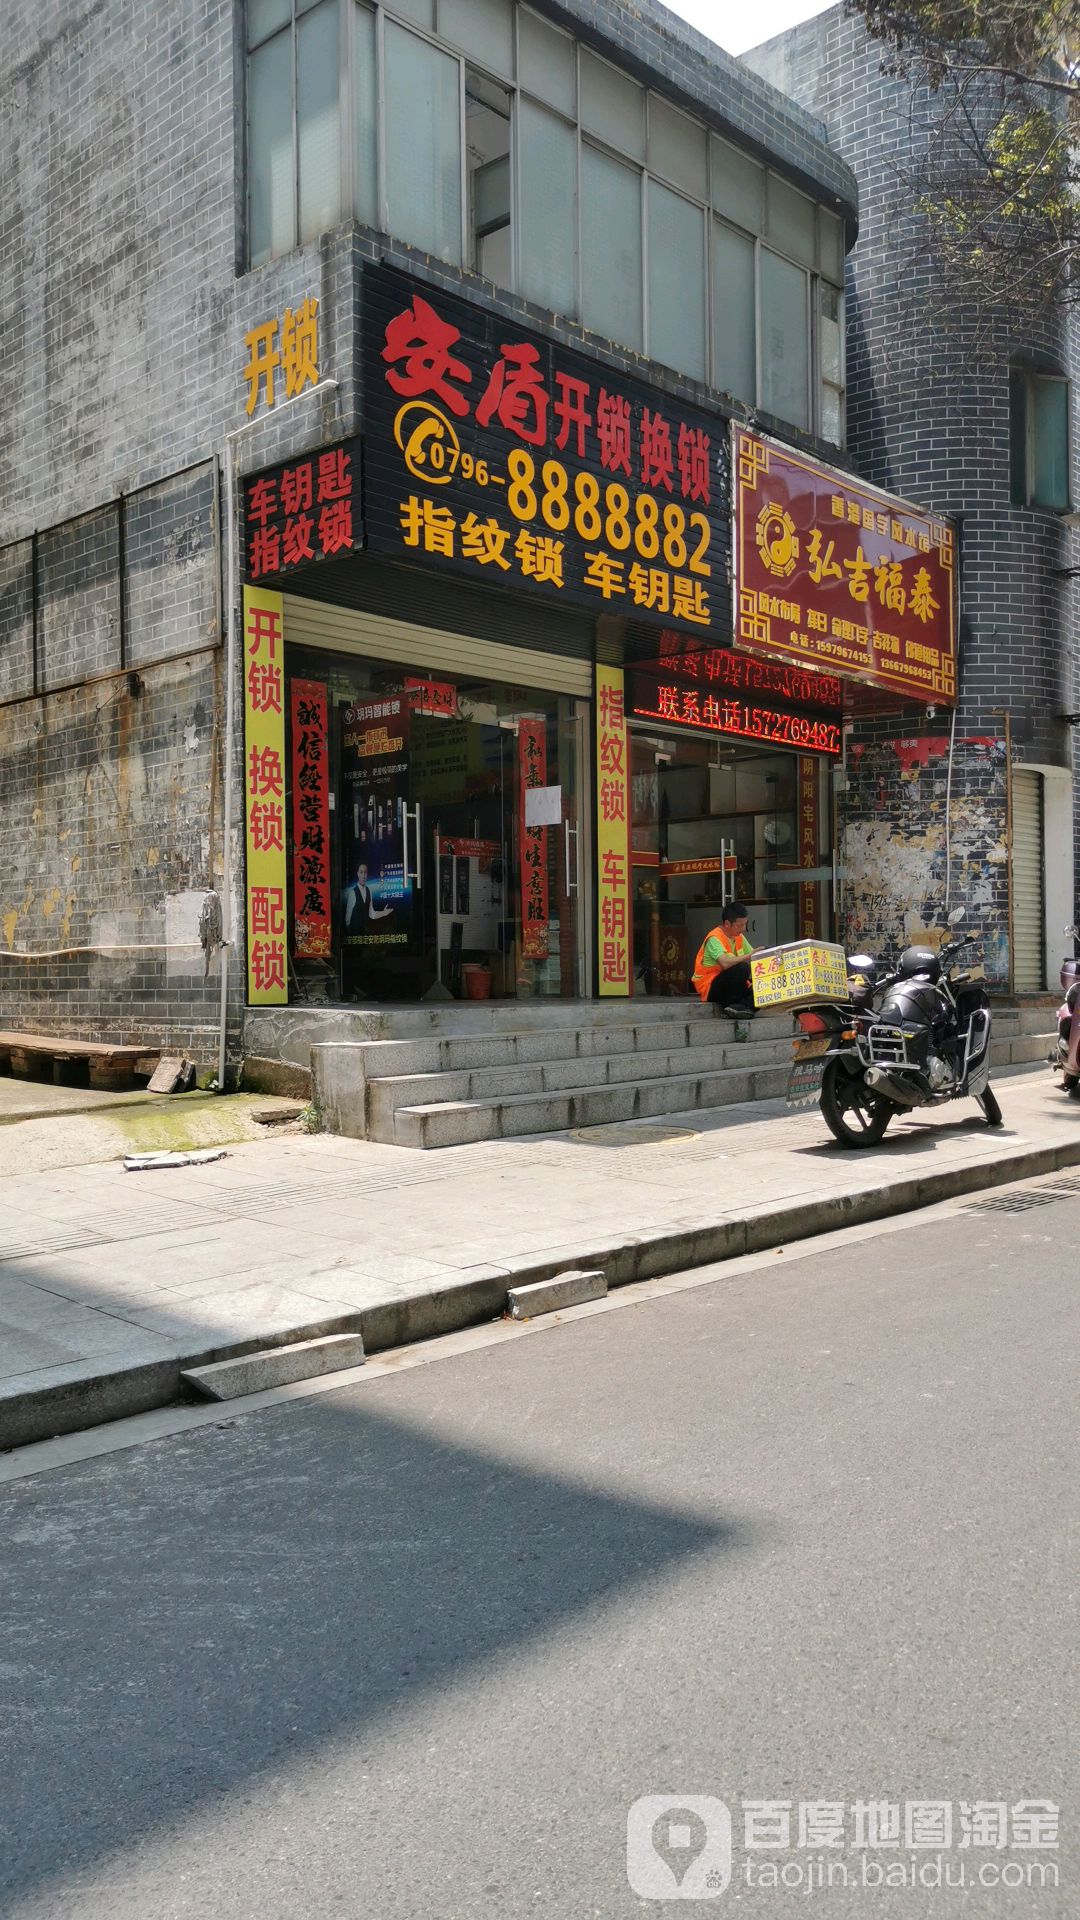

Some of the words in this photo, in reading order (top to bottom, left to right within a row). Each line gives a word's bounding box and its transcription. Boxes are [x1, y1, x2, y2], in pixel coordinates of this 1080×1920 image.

[245, 297, 320, 416] 开锁
[249, 448, 353, 527] 车钥匙
[250, 499, 353, 579] 指纹锁
[400, 496, 565, 588] 指纹锁
[583, 552, 712, 626] 车钥匙
[805, 529, 940, 624] 弘吉福泰
[248, 607, 282, 714] 开锁
[250, 744, 284, 853] 换锁
[600, 684, 625, 822] 指纹锁
[251, 886, 286, 991] 配锁
[601, 849, 627, 984] 车钥匙
